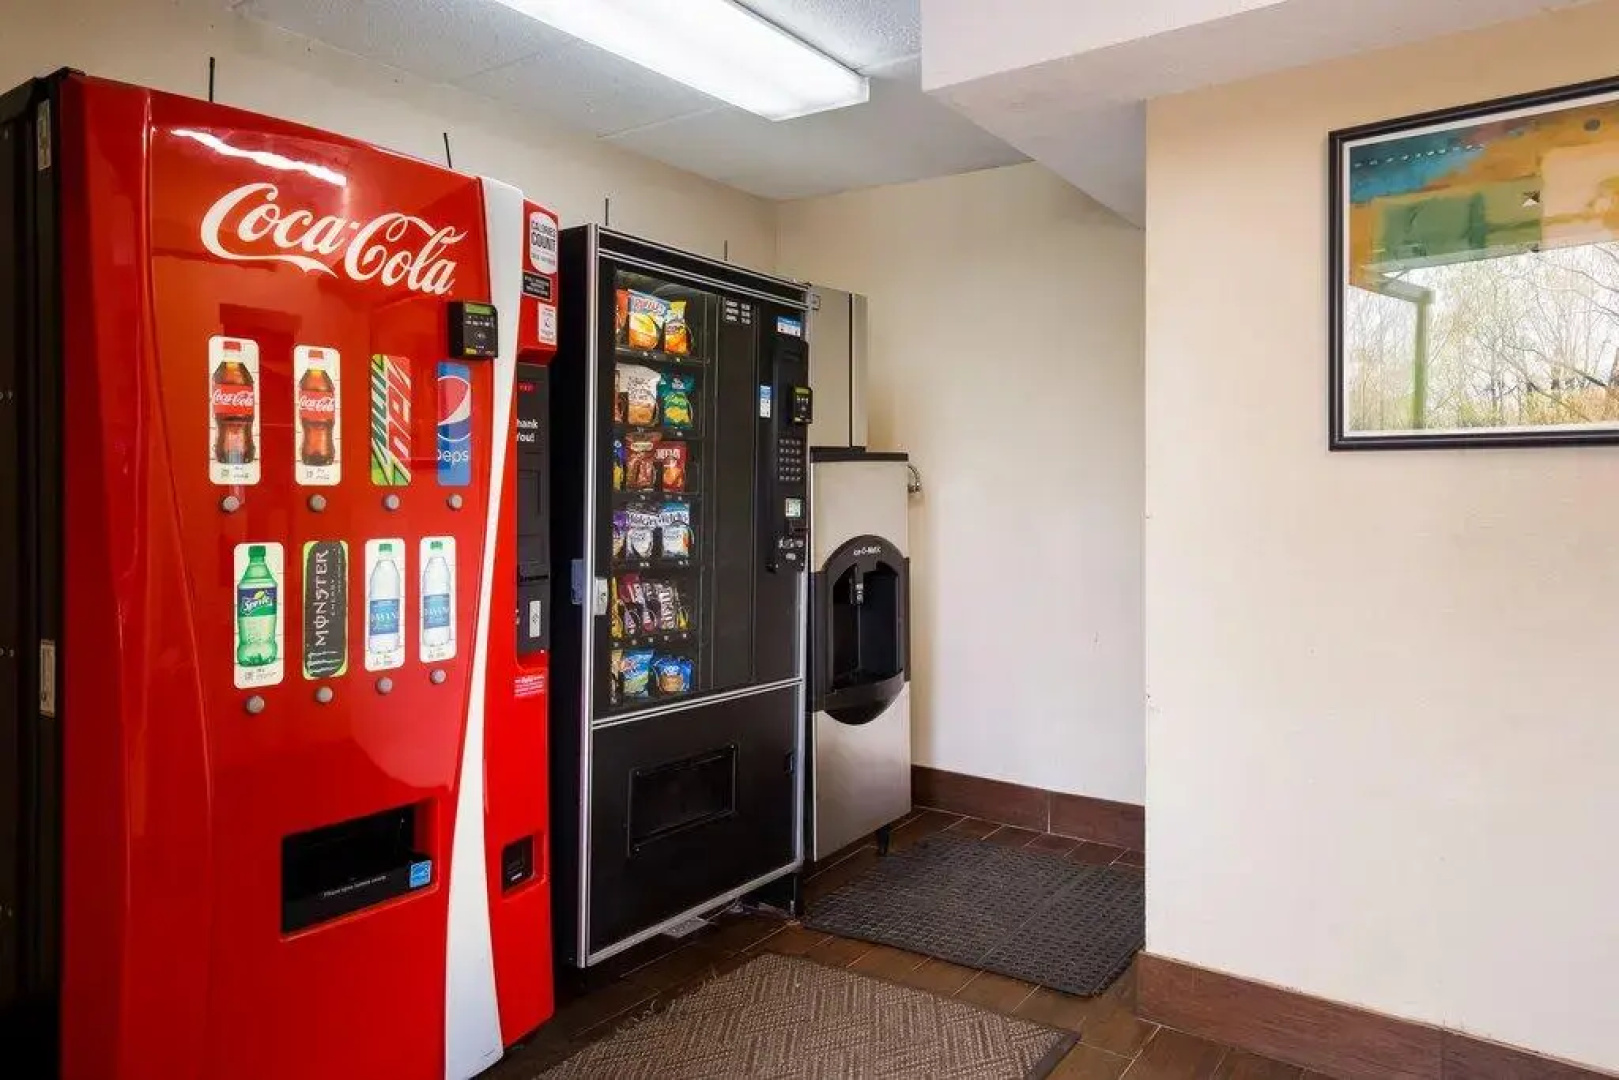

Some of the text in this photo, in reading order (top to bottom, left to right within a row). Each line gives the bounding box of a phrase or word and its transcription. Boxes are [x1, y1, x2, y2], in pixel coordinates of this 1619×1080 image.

[200, 182, 468, 296] Coca-Cola
[213, 388, 255, 407] Coca-Cola
[516, 418, 539, 429] hank
[312, 548, 330, 647] MONSTER
